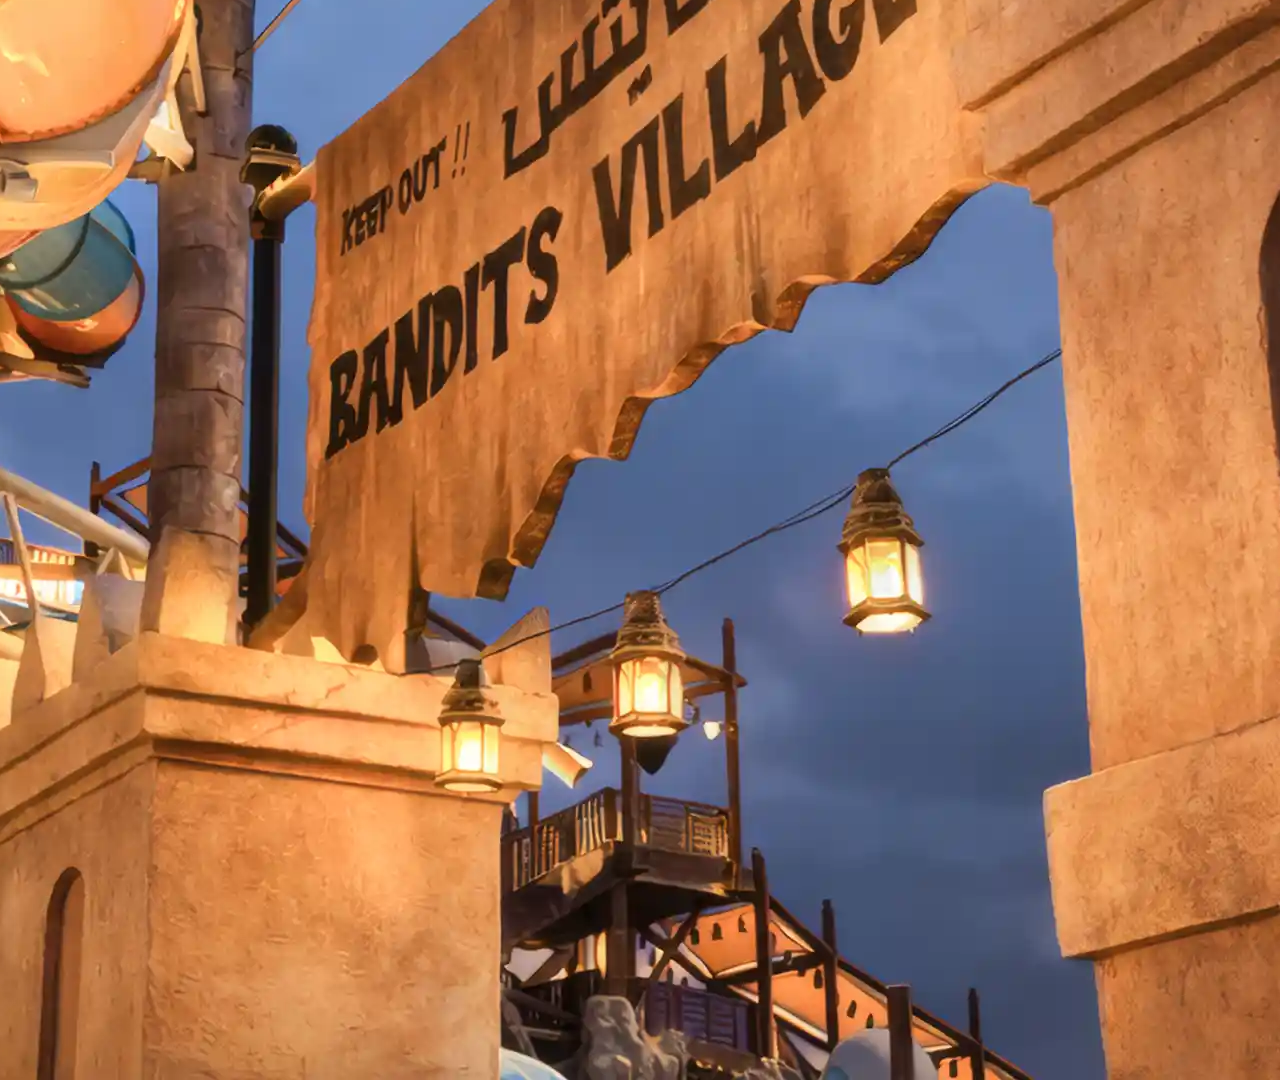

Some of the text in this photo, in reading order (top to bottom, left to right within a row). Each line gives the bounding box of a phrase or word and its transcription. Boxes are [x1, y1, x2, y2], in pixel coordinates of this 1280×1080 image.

[340, 184, 394, 257] KEEP
[398, 135, 448, 216] OUT
[325, 206, 563, 460] BANDITS
